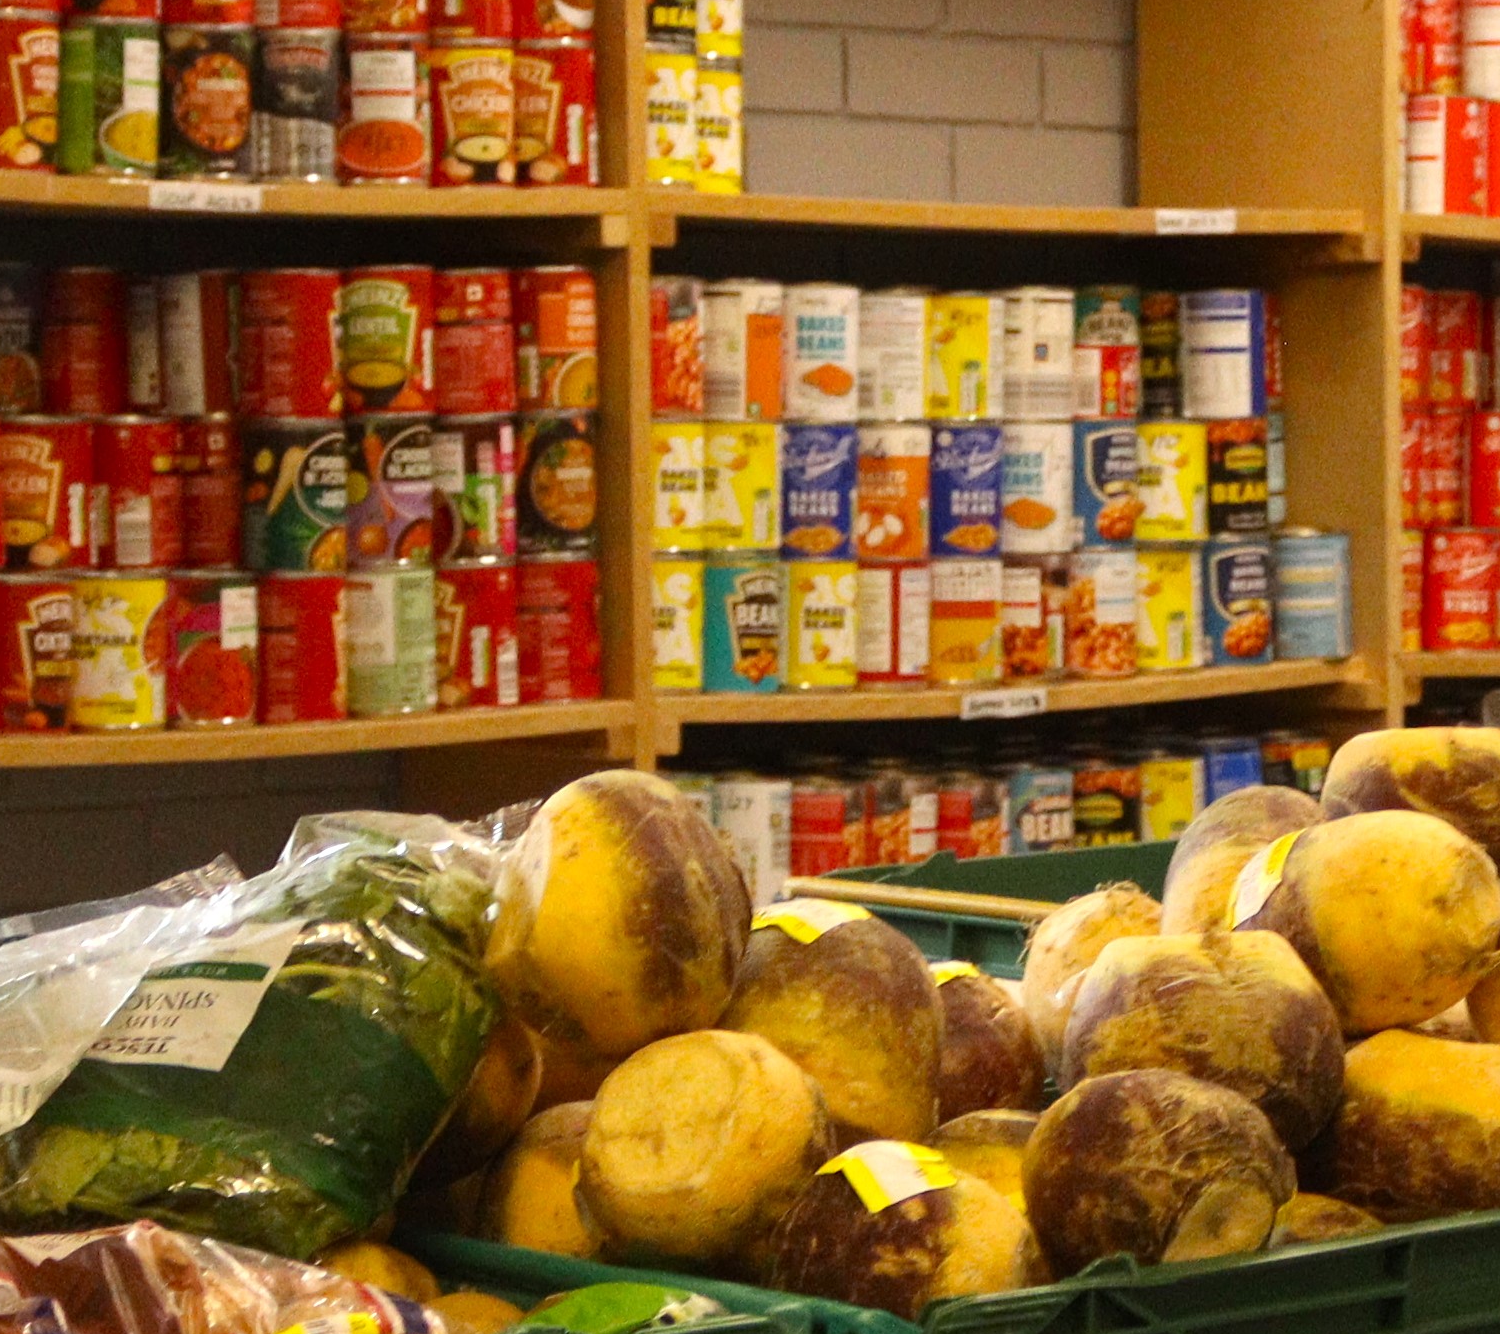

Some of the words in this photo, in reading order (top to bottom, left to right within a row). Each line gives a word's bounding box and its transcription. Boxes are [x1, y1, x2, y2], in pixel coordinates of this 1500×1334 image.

[788, 503, 839, 517] BEANS
[126, 989, 219, 1010] SPINAC
[118, 1015, 180, 1028] BABY
[91, 1037, 177, 1055] TESCO
